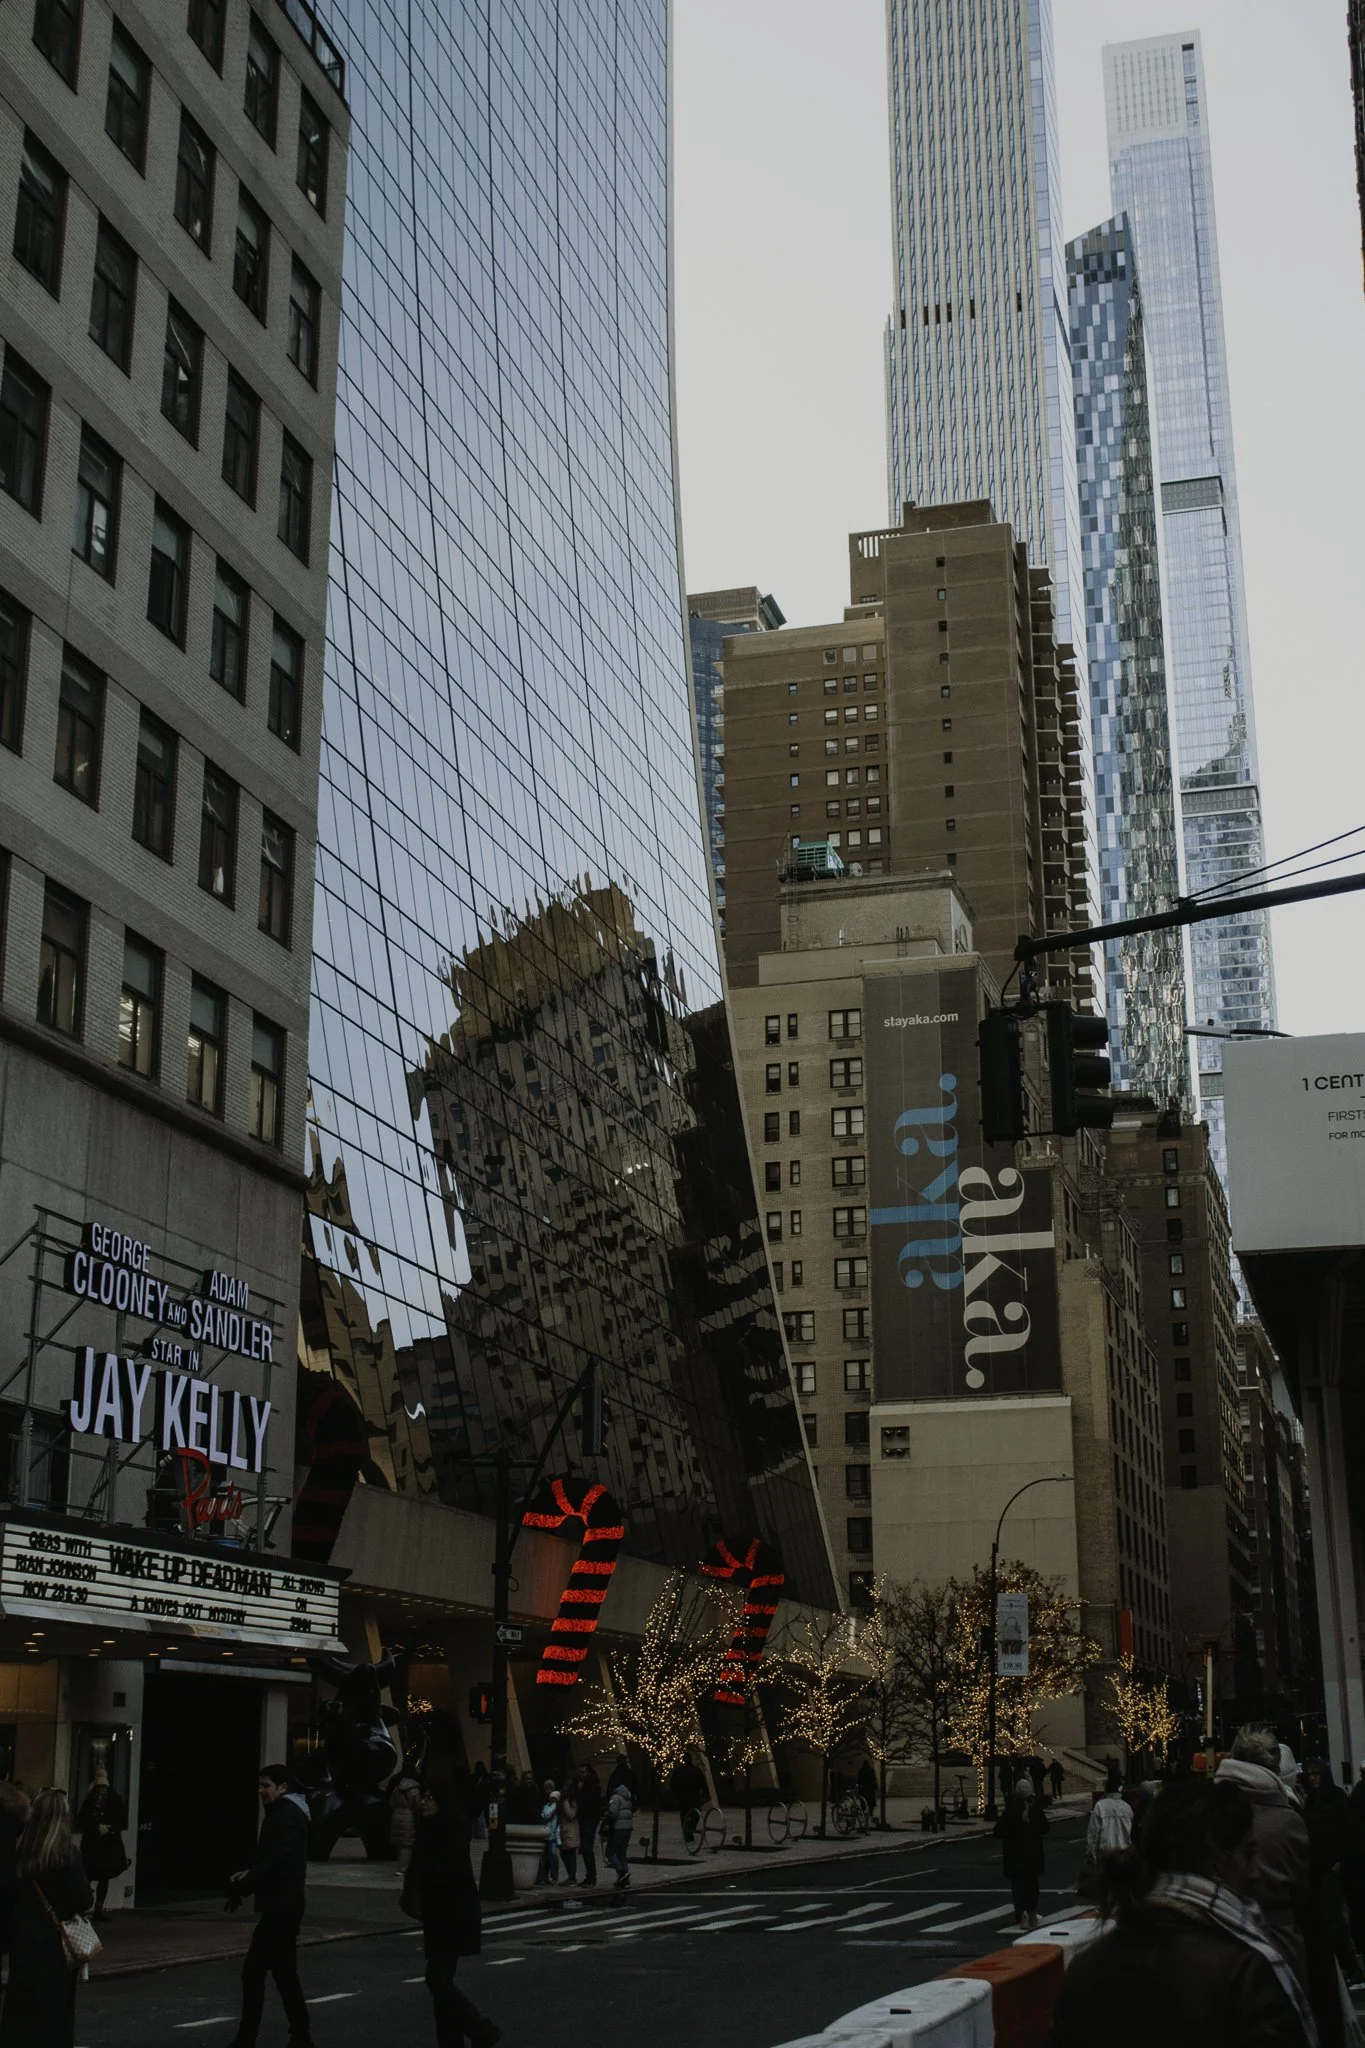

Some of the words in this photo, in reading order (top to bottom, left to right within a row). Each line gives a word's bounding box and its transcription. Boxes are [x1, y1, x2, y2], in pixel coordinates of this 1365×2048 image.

[884, 1013, 959, 1028] stayaka.com
[1302, 1077, 1309, 1091] 1
[1328, 1109, 1365, 1121] FIRST
[1329, 1131, 1348, 1140] FOR
[870, 1072, 964, 1290] aka
[92, 1222, 151, 1273] GEORGE
[209, 1270, 249, 1310] ADAM
[958, 1166, 1055, 1389] aka
[73, 1251, 169, 1322] CLOONEY
[167, 1305, 188, 1325] AND
[190, 1300, 273, 1362] SANDLER
[151, 1338, 182, 1366] STAR
[188, 1350, 200, 1370] IN
[70, 1346, 152, 1443] JAY
[162, 1370, 272, 1473] KELLY
[65, 1537, 92, 1556] WITH
[16, 1554, 44, 1572] RIAN
[46, 1558, 97, 1580] JOHNSON
[109, 1545, 160, 1581] WAKE
[163, 1555, 187, 1585] UP
[23, 1580, 48, 1599] NOV
[282, 1575, 296, 1590] ALL
[299, 1578, 325, 1594] SHOWS
[131, 1595, 139, 1611] A
[144, 1597, 178, 1615] KNIVES
[183, 1602, 203, 1619] OUT
[209, 1606, 246, 1625] MYSTERY
[296, 1597, 307, 1612] ON
